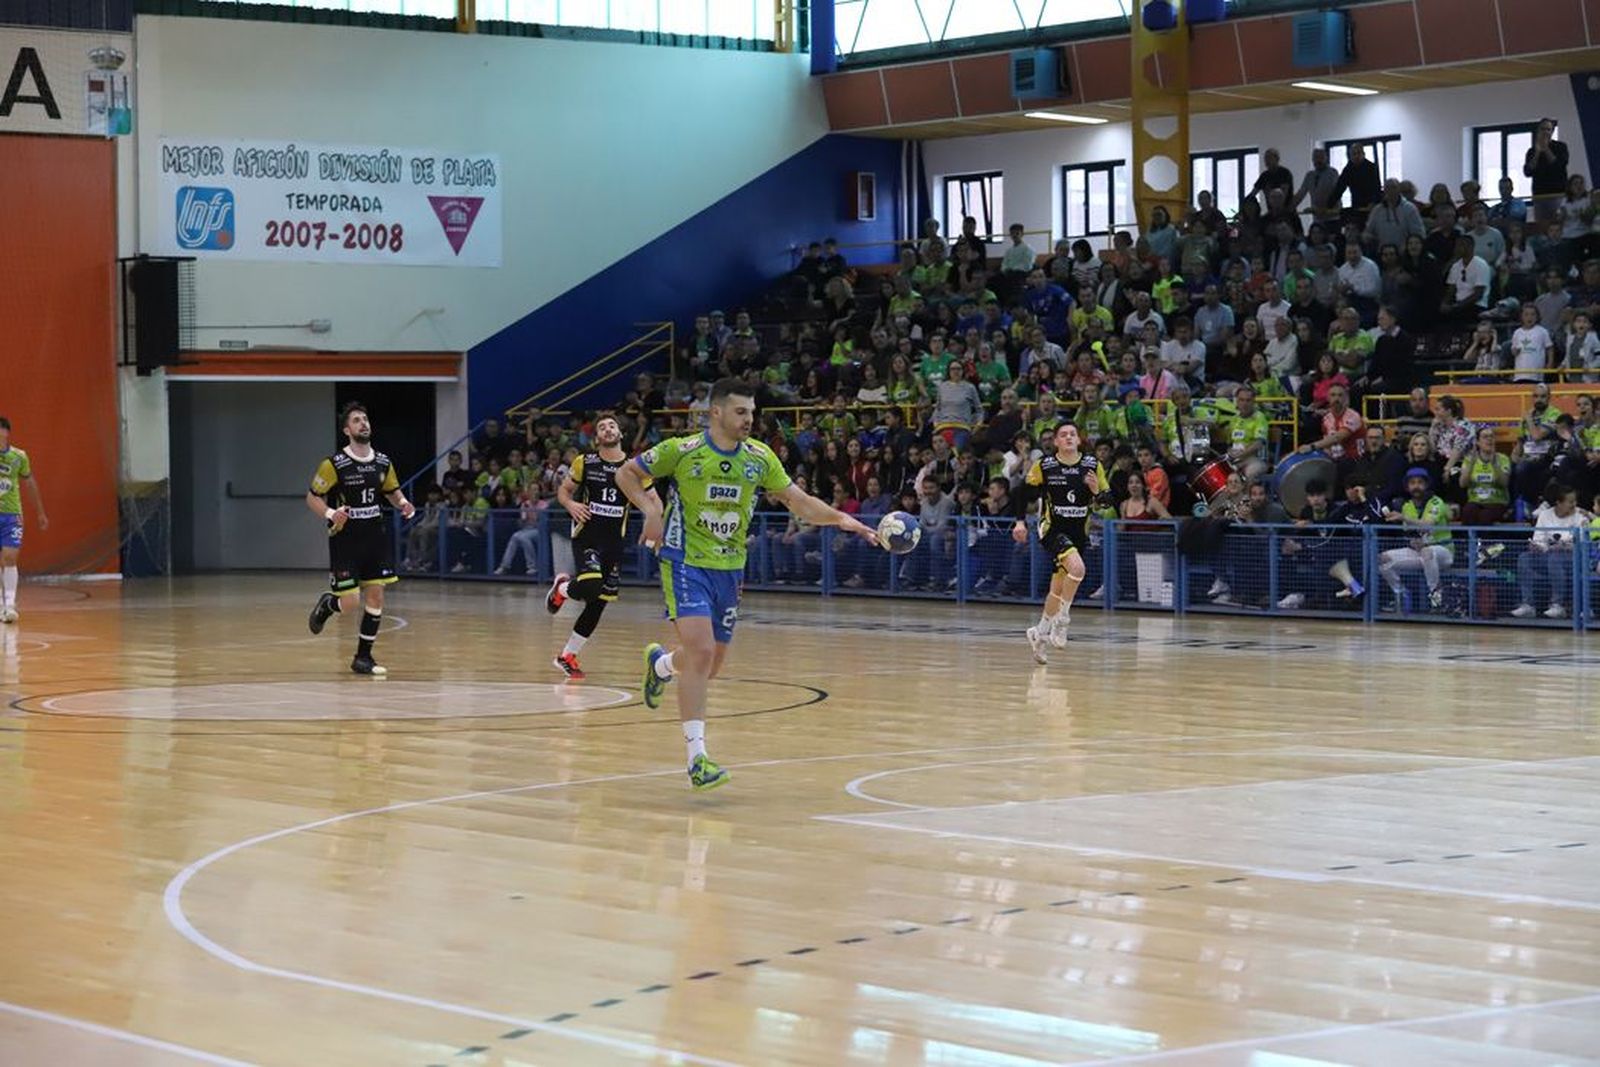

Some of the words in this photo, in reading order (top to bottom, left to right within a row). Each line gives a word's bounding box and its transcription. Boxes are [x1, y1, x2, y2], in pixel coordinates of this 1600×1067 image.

[0, 46, 62, 120] A
[162, 145, 224, 178] MEJOR
[234, 144, 309, 179] AFICIÓN
[319, 149, 402, 184] DIVISIÓN
[411, 158, 436, 184] DE
[442, 158, 497, 187] PLATA
[285, 193, 383, 213] TEMPORADA
[265, 219, 404, 253] 2007-2008
[361, 487, 376, 504] 15
[600, 487, 618, 502] 13
[709, 486, 738, 499] gaza
[1066, 489, 1076, 503] 6
